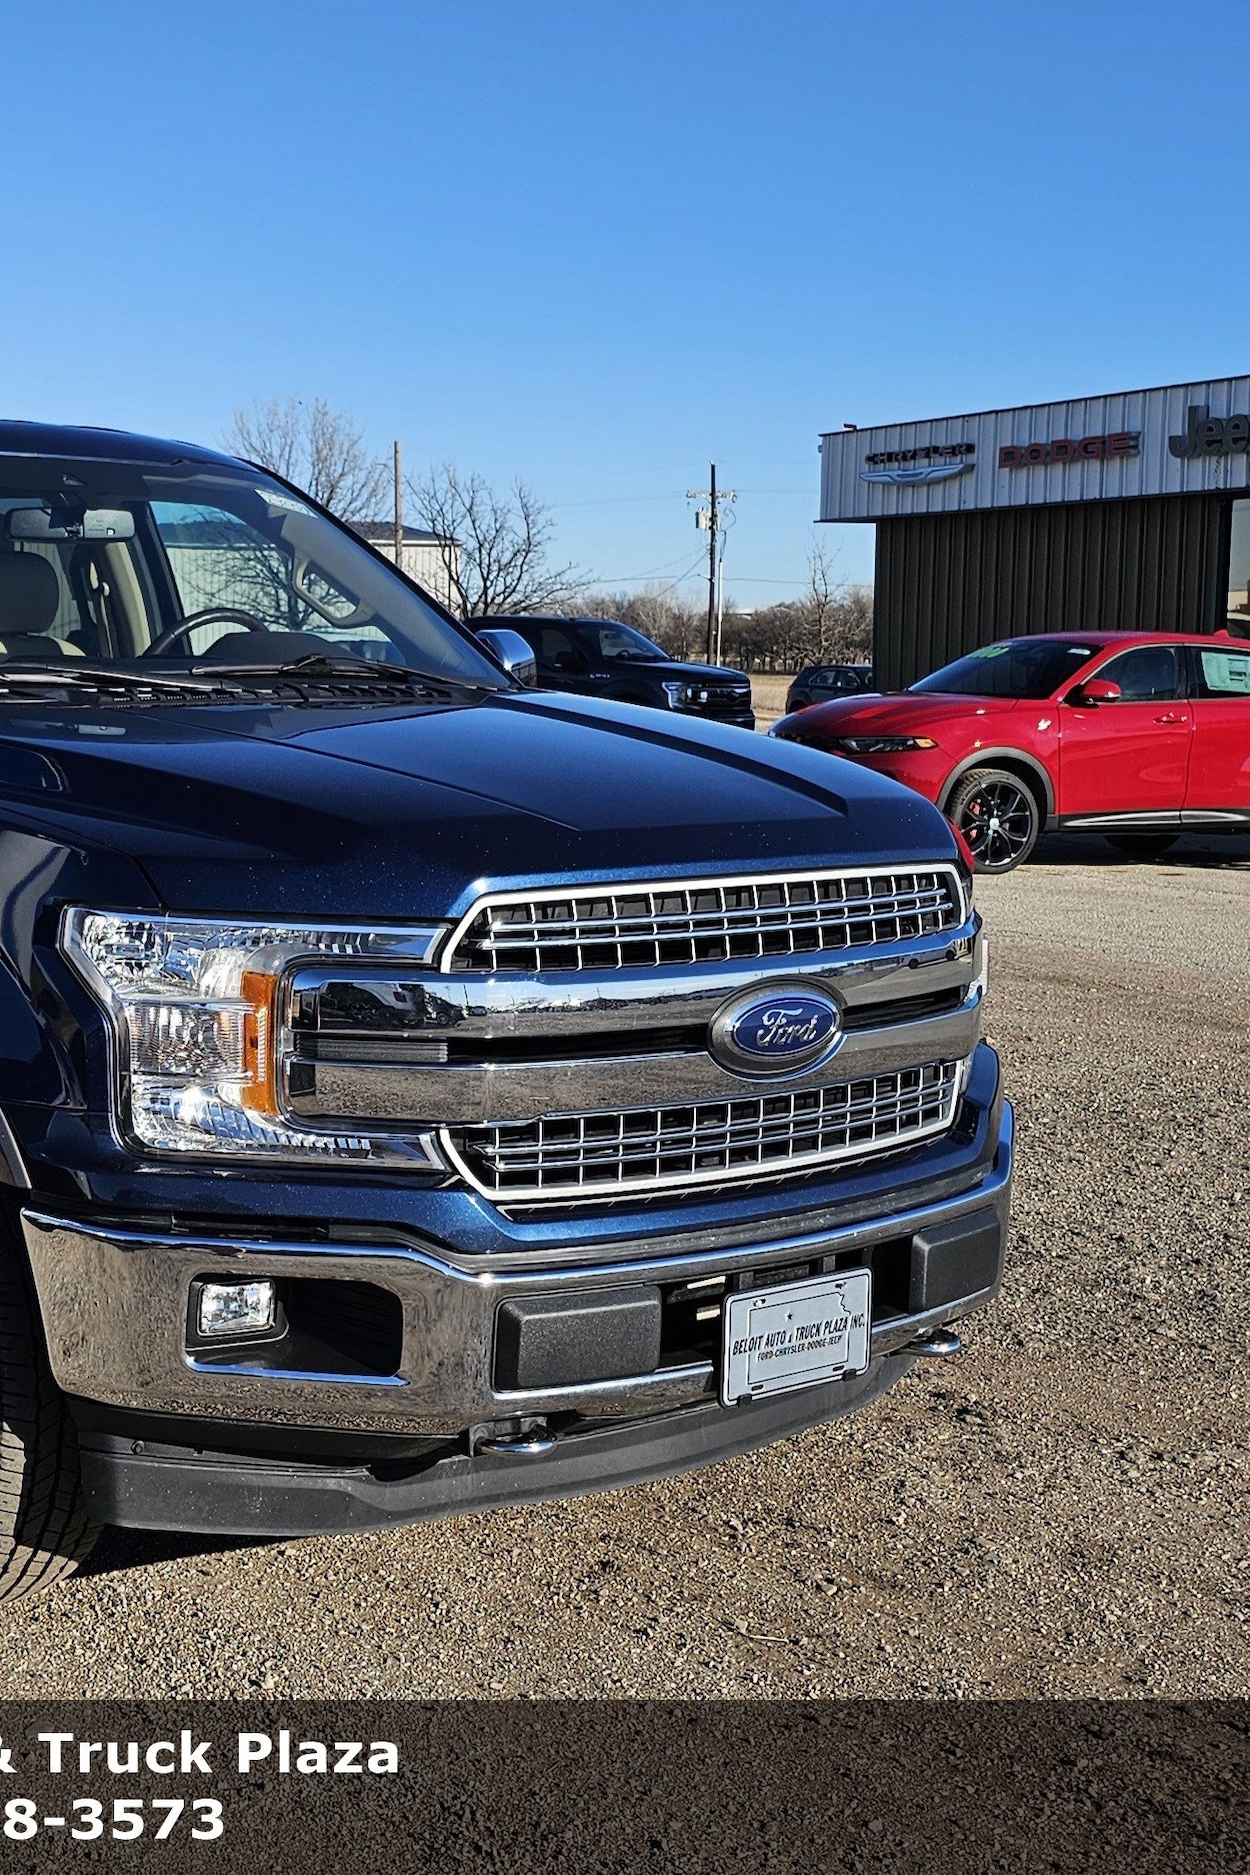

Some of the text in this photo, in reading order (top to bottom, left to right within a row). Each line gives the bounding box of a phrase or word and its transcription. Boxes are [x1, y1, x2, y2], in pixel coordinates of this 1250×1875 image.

[998, 431, 1141, 469] DODGE
[1168, 404, 1250, 459] Jee
[865, 442, 976, 466] CHRYSLER
[756, 1008, 819, 1047] Ford
[732, 1334, 764, 1356] BELOIT
[764, 1330, 787, 1348] AUTO
[794, 1321, 823, 1342] TRUCK
[823, 1316, 848, 1336] PLAZA
[849, 1313, 866, 1331] INC.
